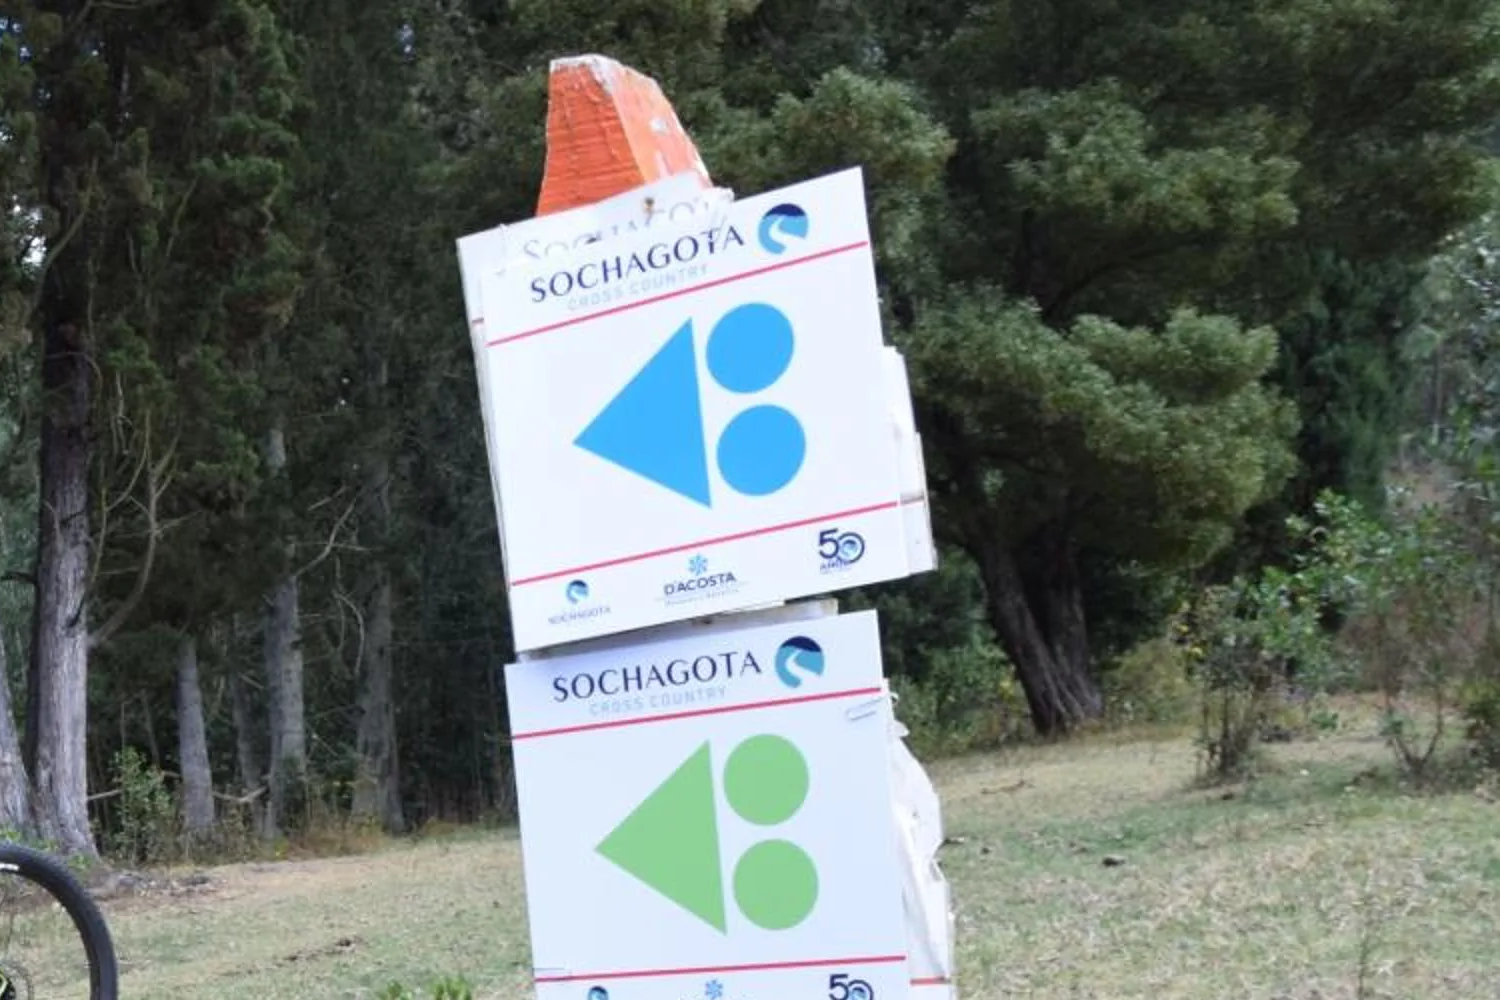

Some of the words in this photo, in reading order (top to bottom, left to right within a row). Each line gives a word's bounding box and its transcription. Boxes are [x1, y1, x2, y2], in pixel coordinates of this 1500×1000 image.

[530, 224, 745, 304] SOCHAGOTA
[663, 571, 737, 596] D'ACOSTA
[553, 650, 763, 703] SOCHAGOTA
[590, 698, 645, 717] CROSS
[651, 685, 727, 708] COUNTRY
